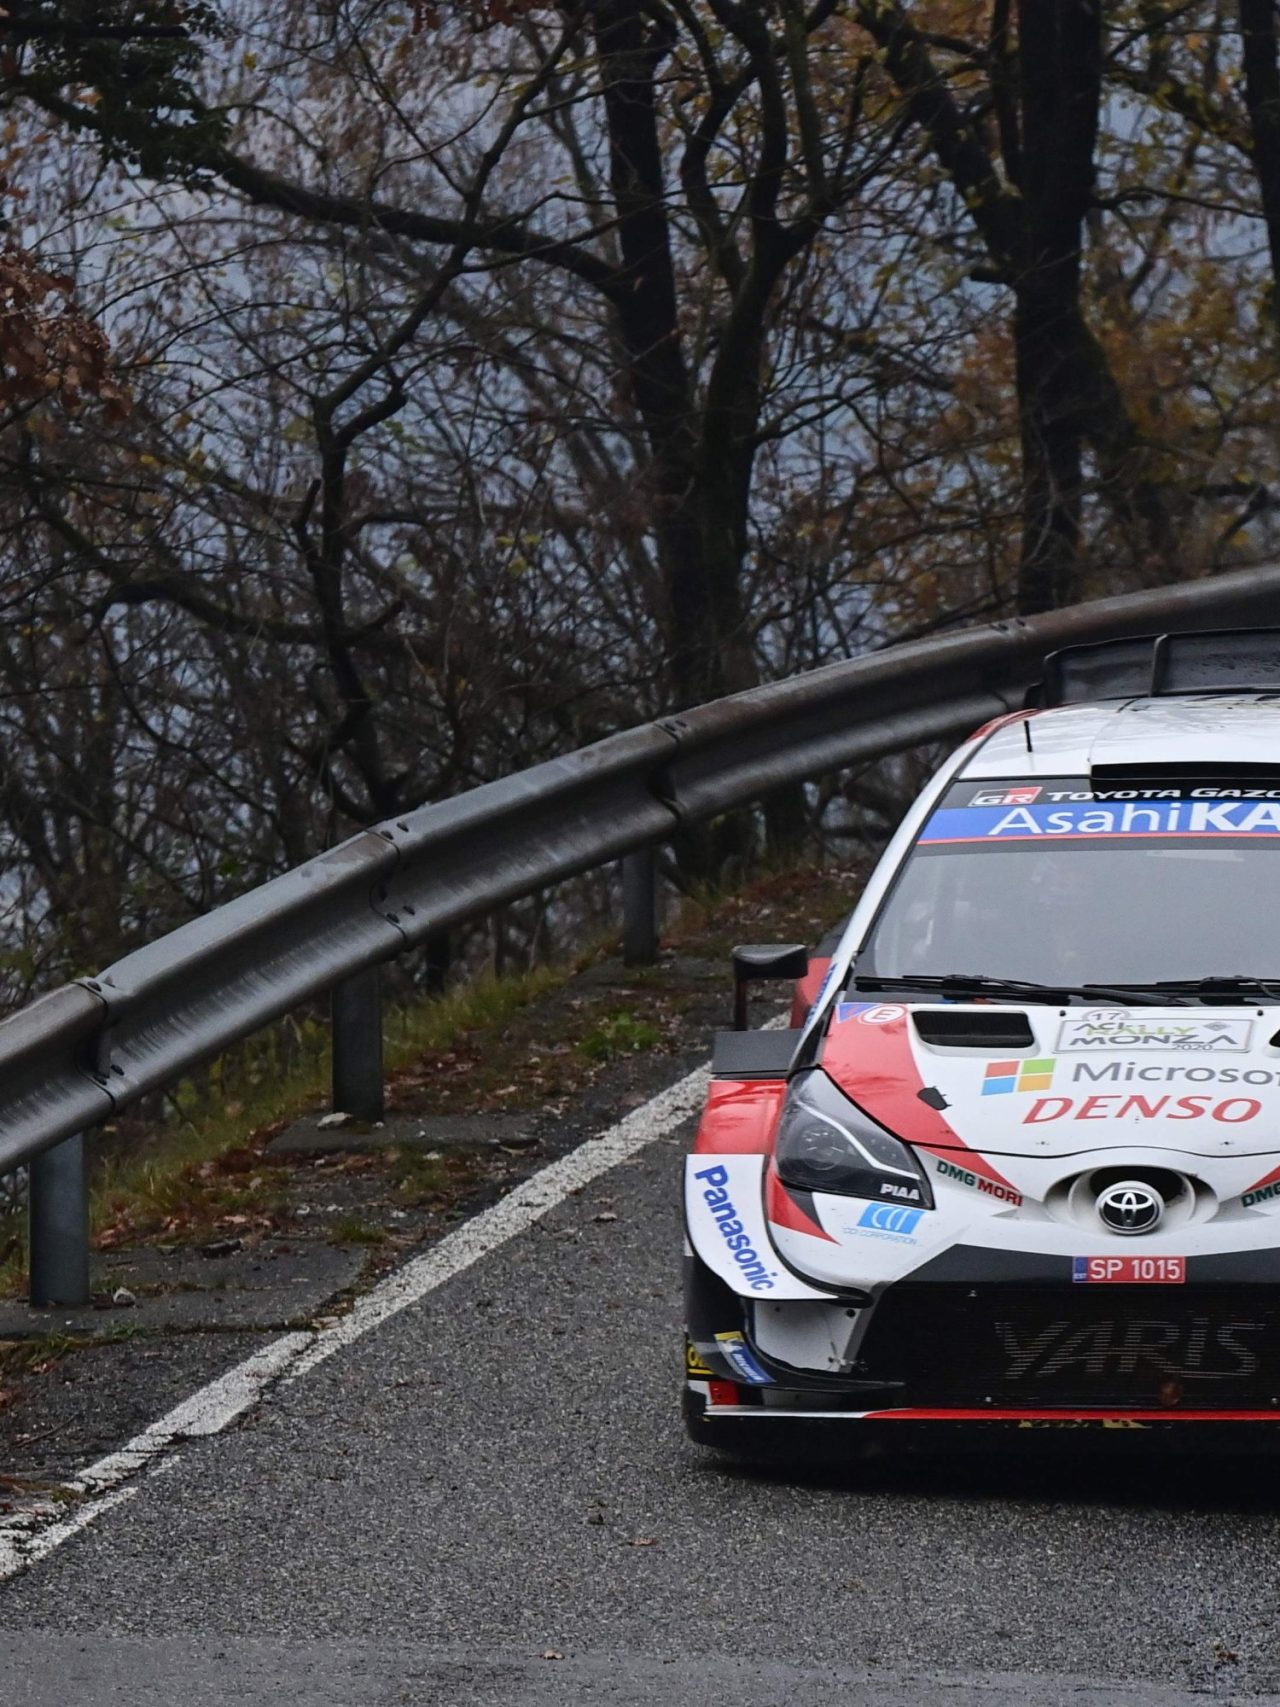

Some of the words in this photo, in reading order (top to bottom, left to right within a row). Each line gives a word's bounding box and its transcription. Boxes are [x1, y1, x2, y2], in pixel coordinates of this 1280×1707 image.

[973, 793, 1033, 806] GR
[1047, 788, 1182, 801] TOYOTA
[1092, 1012, 1121, 1021] 17
[1069, 1034, 1239, 1045] MONZA
[1022, 1095, 1262, 1124] DENSO
[881, 1184, 919, 1200] PIAA
[936, 1160, 976, 1187] DMG
[977, 1178, 1024, 1207] MORI
[694, 1164, 776, 1291] Panasonic
[1090, 1260, 1123, 1279] SP
[1131, 1260, 1180, 1279] 1015
[994, 1317, 1265, 1379] YARIS
